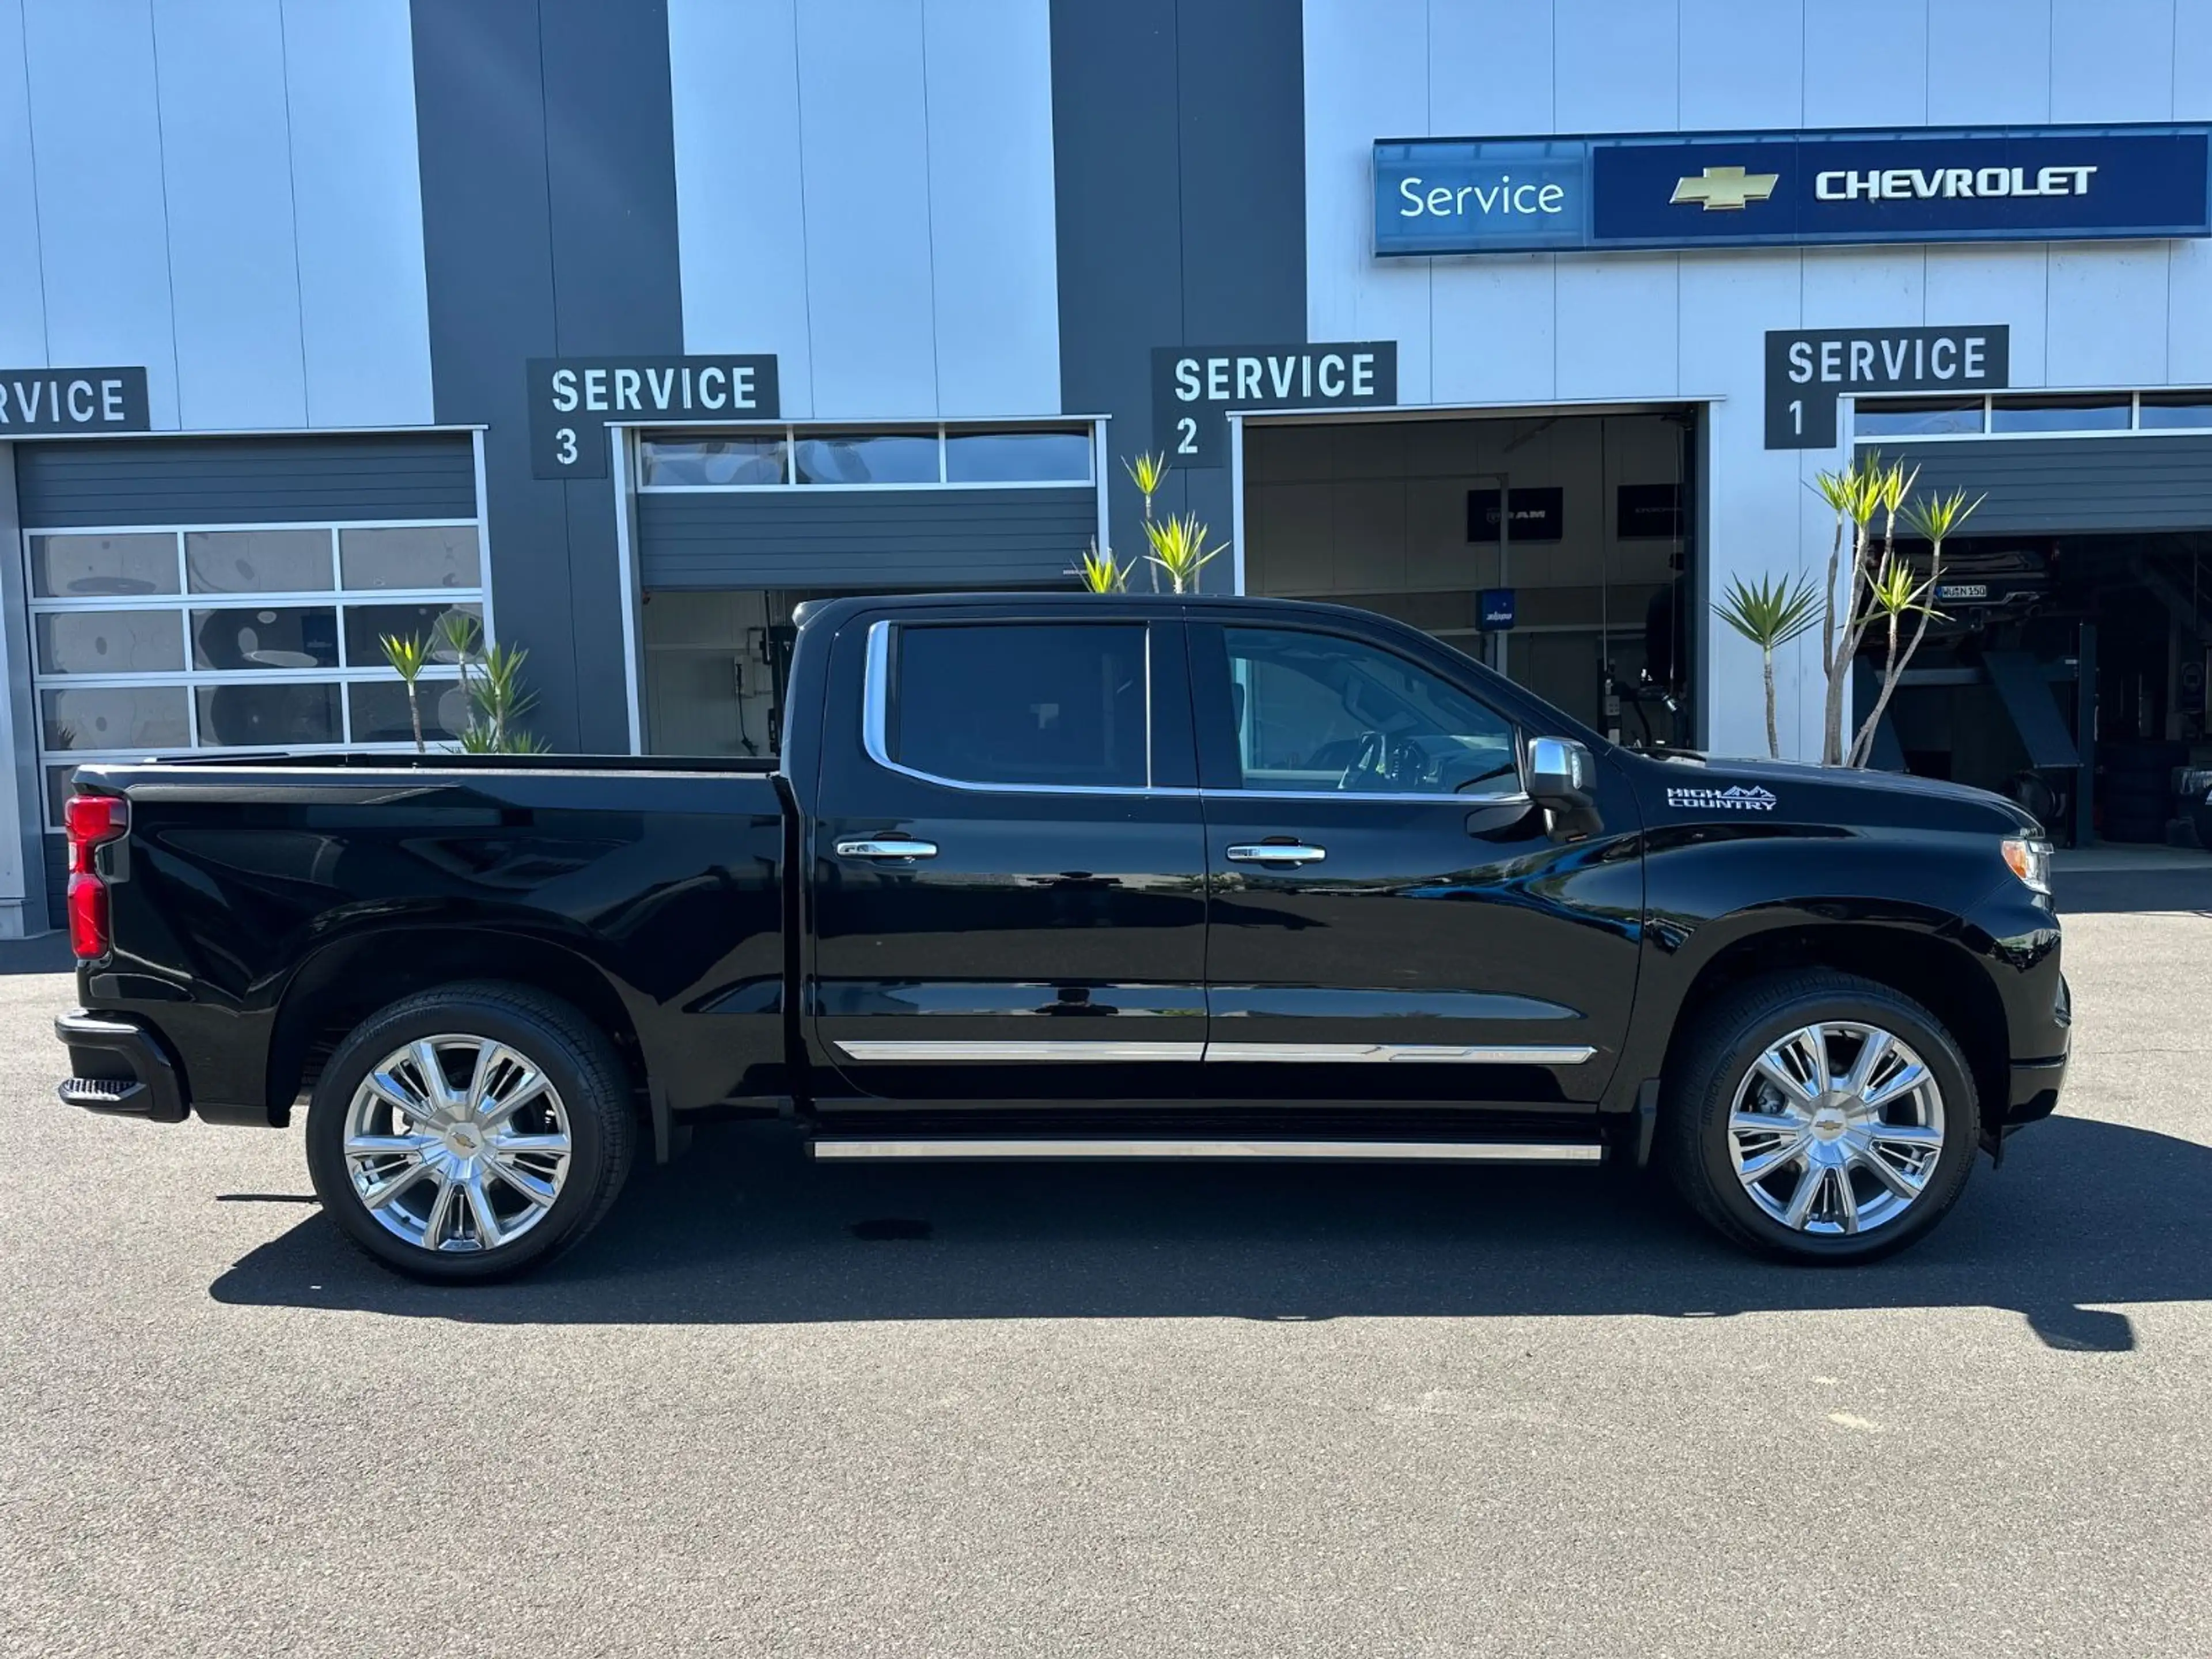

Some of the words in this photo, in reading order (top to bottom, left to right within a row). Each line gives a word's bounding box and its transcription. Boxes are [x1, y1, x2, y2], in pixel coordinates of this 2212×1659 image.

[1400, 175, 1565, 217] Service
[1816, 166, 2097, 200] CHEVROLET
[1175, 354, 1374, 402] SERVICE
[1789, 338, 1986, 383] SERVICE
[552, 367, 756, 412] SERVICE
[1177, 417, 1198, 454] 2
[1789, 400, 1802, 435] 1
[556, 428, 578, 464] 3
[1666, 787, 1721, 798] HIGH
[1668, 798, 1777, 811] COUNTRY
